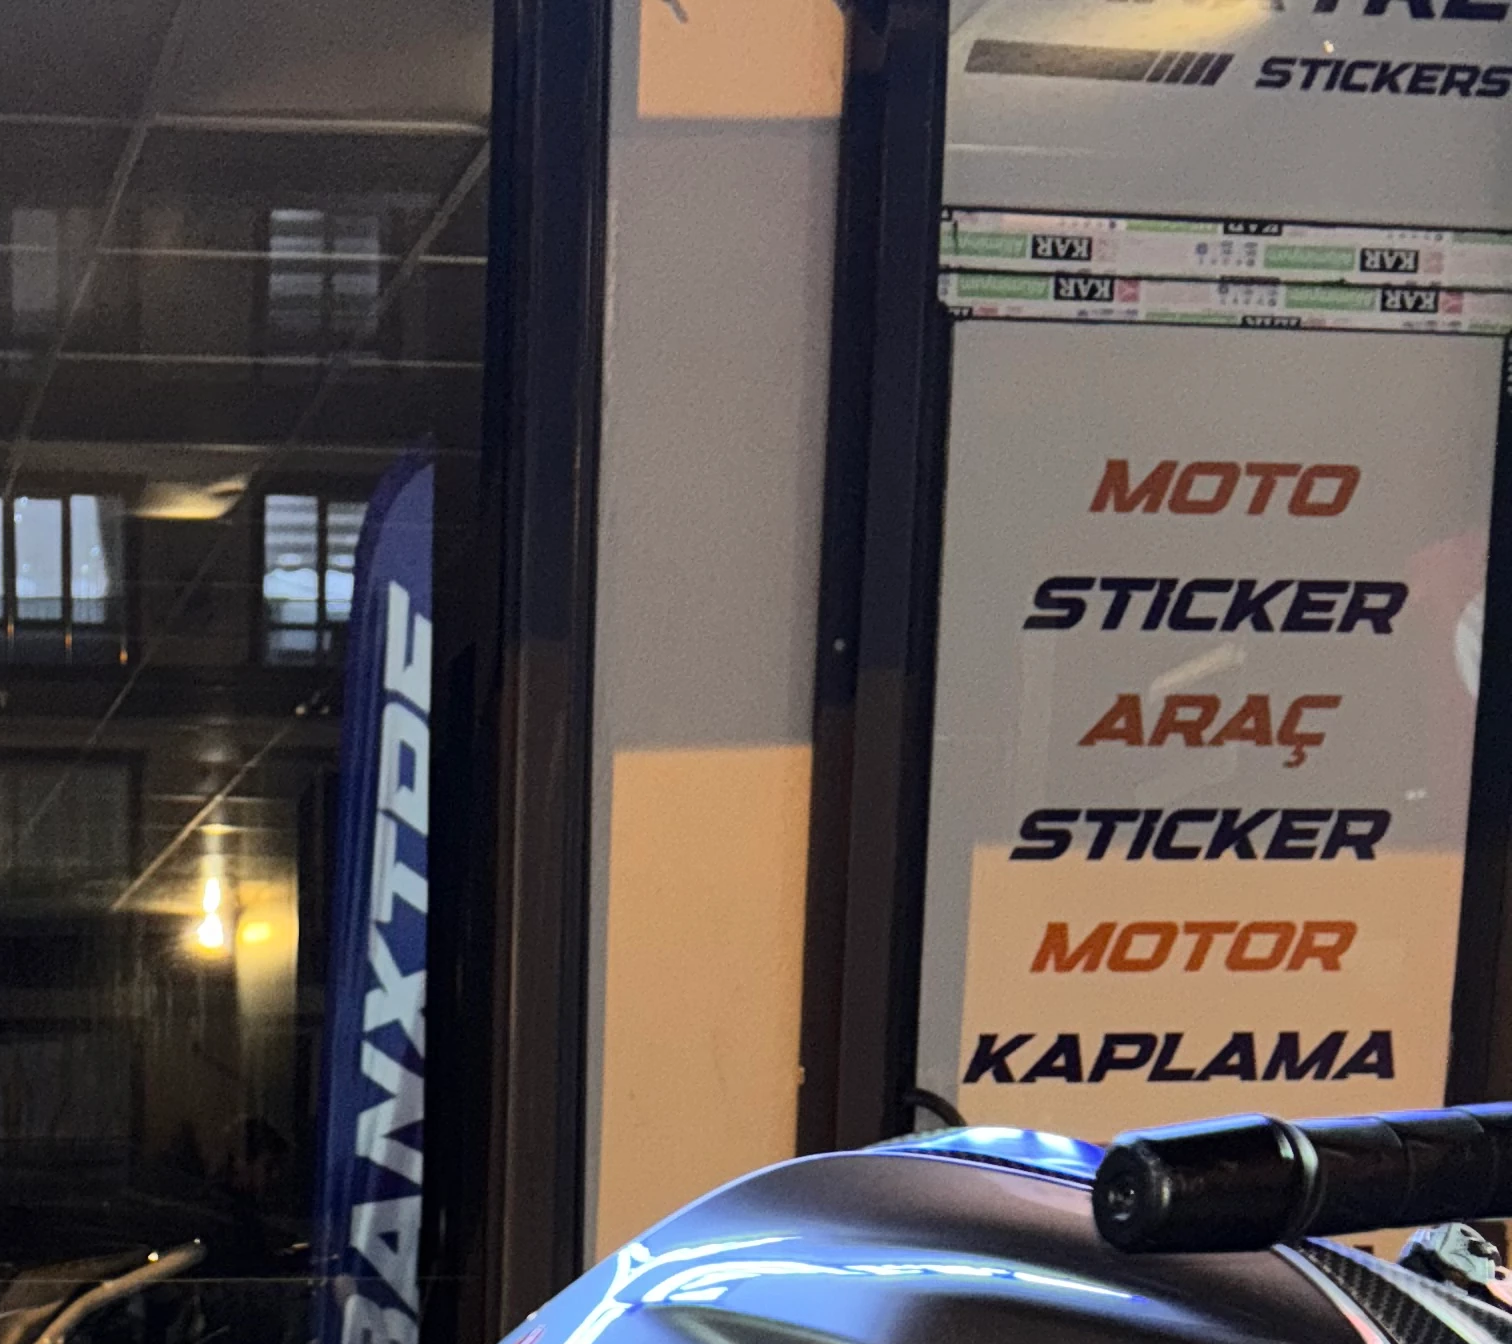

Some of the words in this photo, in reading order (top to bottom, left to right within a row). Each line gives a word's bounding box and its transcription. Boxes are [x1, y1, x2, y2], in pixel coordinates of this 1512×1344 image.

[1254, 56, 1512, 97] STICKERS
[1037, 236, 1089, 258] KAR
[1364, 249, 1417, 270] KAR
[1058, 277, 1112, 298] KAR
[1385, 288, 1436, 309] KAR
[1089, 458, 1362, 517] MOTO
[1022, 576, 1409, 634] STICKER
[1077, 693, 1343, 768] ARAÇ
[1009, 808, 1392, 861] STICKER
[1029, 920, 1358, 974] MOTOR
[962, 1030, 1396, 1085] KAPLAMA
